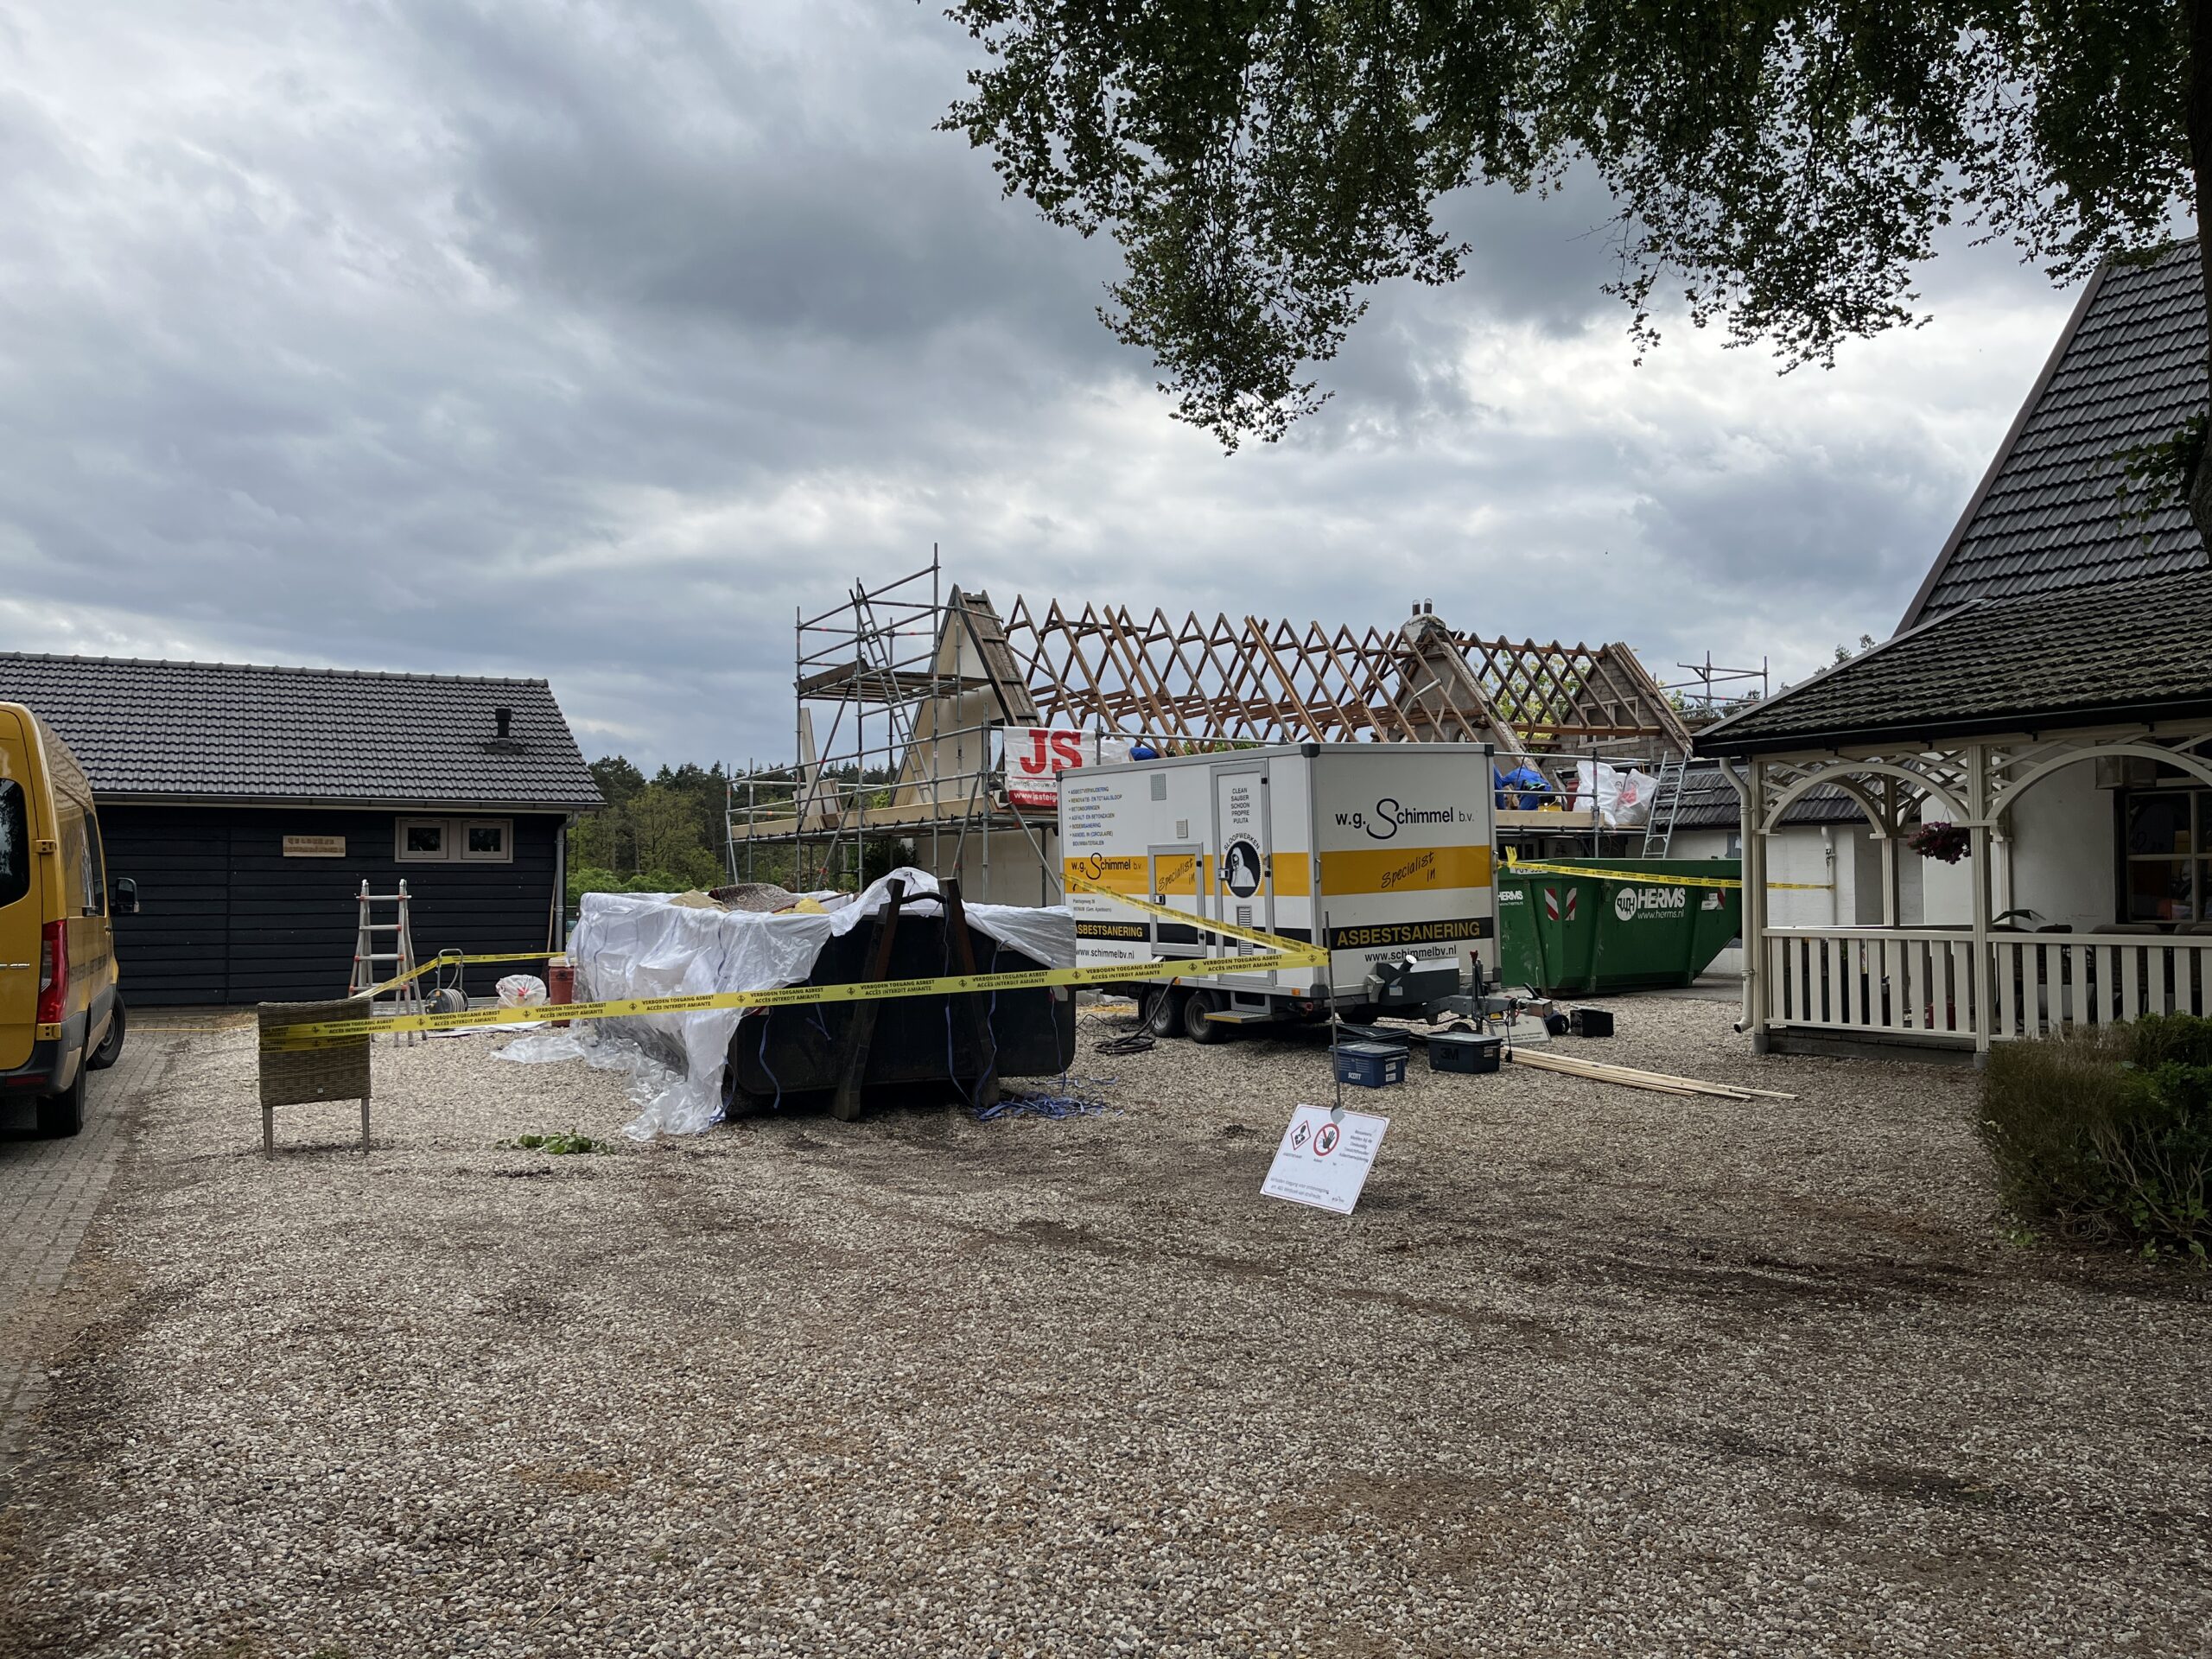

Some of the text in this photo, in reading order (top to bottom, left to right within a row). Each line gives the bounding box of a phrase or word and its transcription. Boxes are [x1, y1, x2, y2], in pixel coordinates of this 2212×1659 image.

[1020, 729, 1083, 774] JS
[1335, 798, 1475, 840] w.g. Schimmel b.v.
[1224, 832, 1260, 850] SLOOPWERKEN
[1086, 852, 1131, 880] Schimmel
[1158, 857, 1193, 891] Specialist
[1381, 851, 1434, 889] Specialist
[1427, 868, 1436, 882] in
[1188, 873, 1195, 885] in
[1497, 890, 1523, 900] HERMS
[1637, 887, 1686, 909] HERMS
[1637, 909, 1684, 919] www.herms.nl
[1337, 921, 1480, 947] ASBESTSANERING
[1364, 944, 1457, 963] www.schimmelbv.nl
[1440, 1047, 1459, 1061] 3M
[1348, 1071, 1362, 1080] SCOTT
